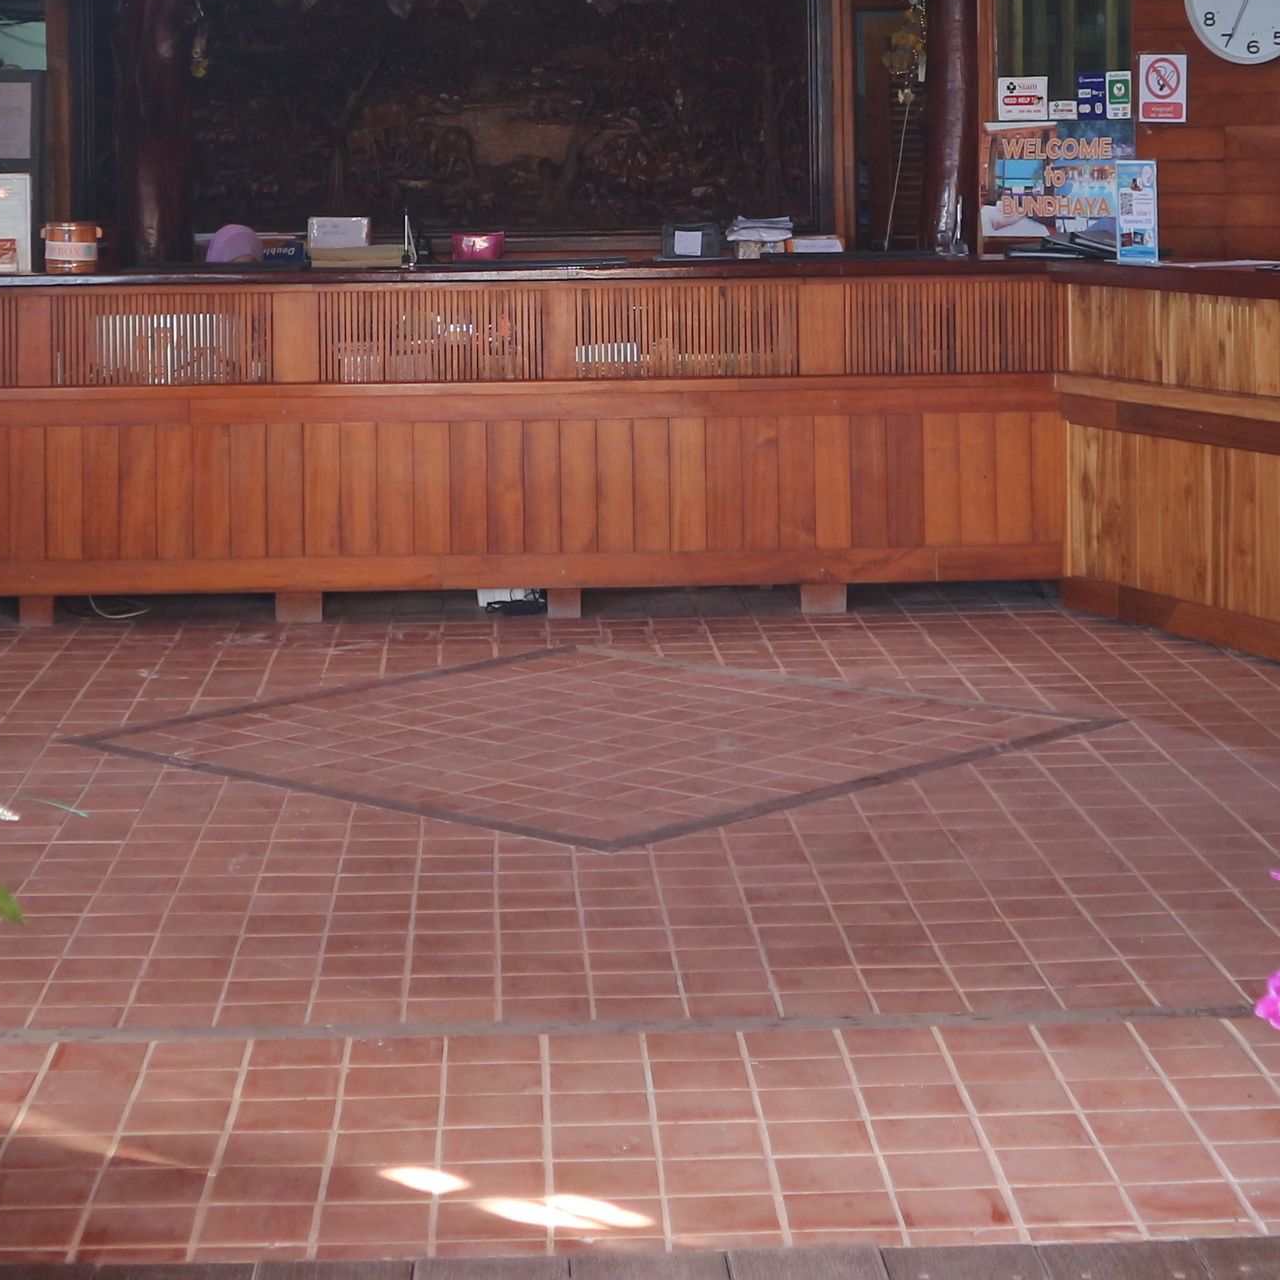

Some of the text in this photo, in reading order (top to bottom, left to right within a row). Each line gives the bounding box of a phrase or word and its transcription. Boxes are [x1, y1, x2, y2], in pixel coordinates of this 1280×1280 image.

[1204, 11, 1216, 27] 8
[1221, 33, 1233, 48] 7
[1247, 40, 1260, 54] 6
[1002, 137, 1112, 159] WELCOME
[1044, 162, 1066, 187] to
[1001, 195, 1112, 217] BUNDHAYA
